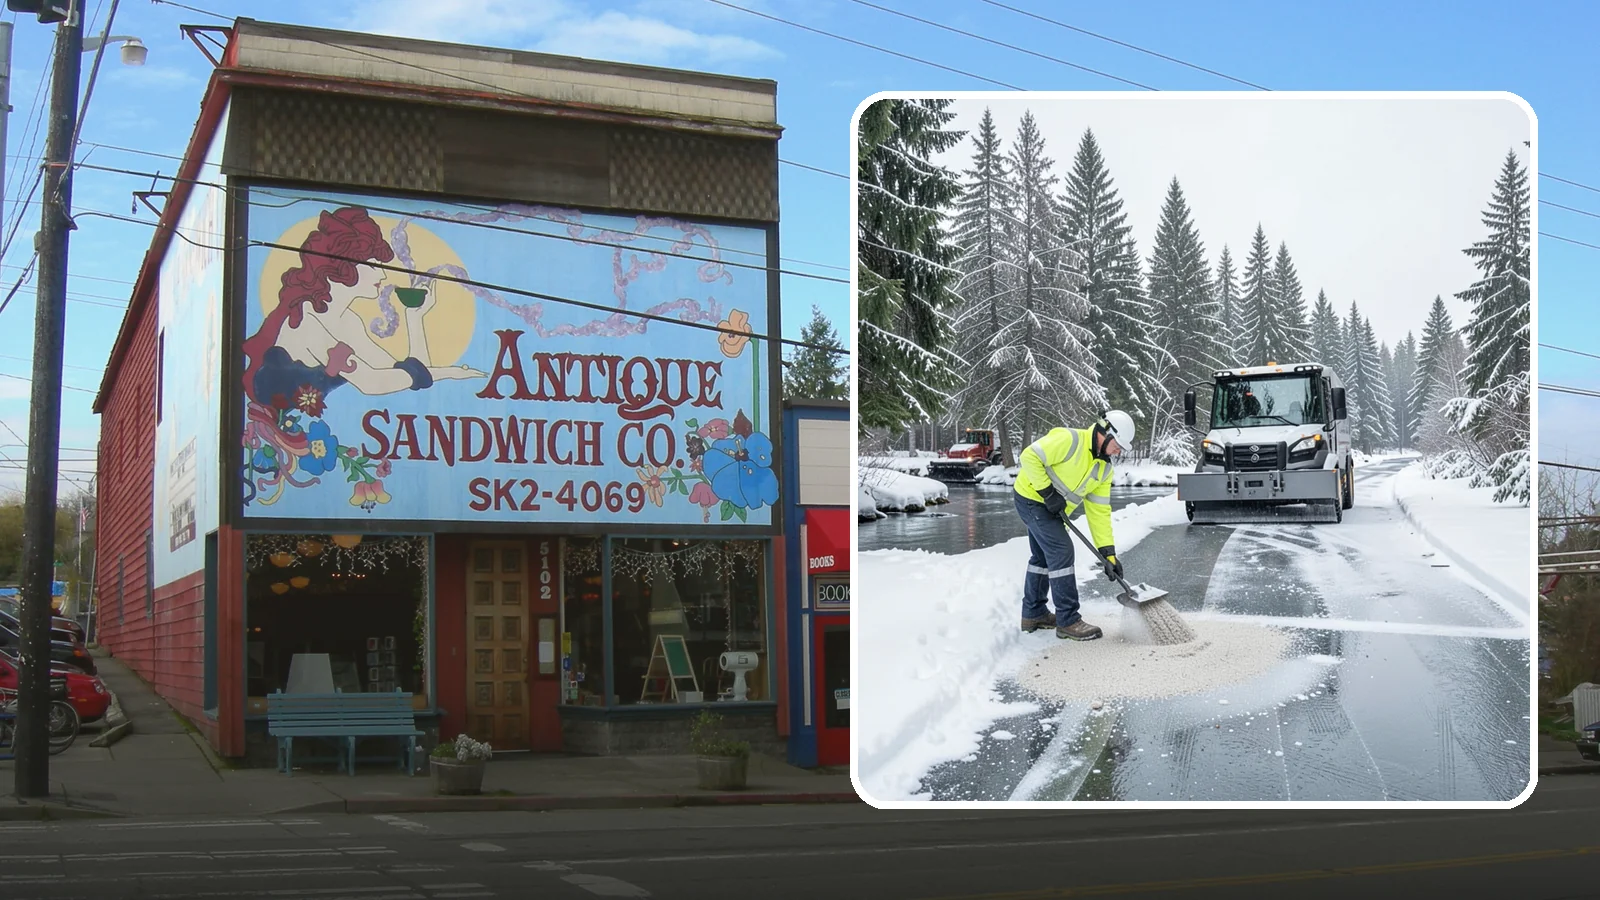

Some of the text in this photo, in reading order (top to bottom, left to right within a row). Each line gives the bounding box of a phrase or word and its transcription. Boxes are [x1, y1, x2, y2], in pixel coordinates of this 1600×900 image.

[476, 329, 724, 421] ANTIQUE
[361, 408, 685, 469] SANDWICH CO.
[468, 477, 646, 513] SK2-4069
[540, 541, 551, 600] 5102
[809, 555, 835, 569] BOOKS
